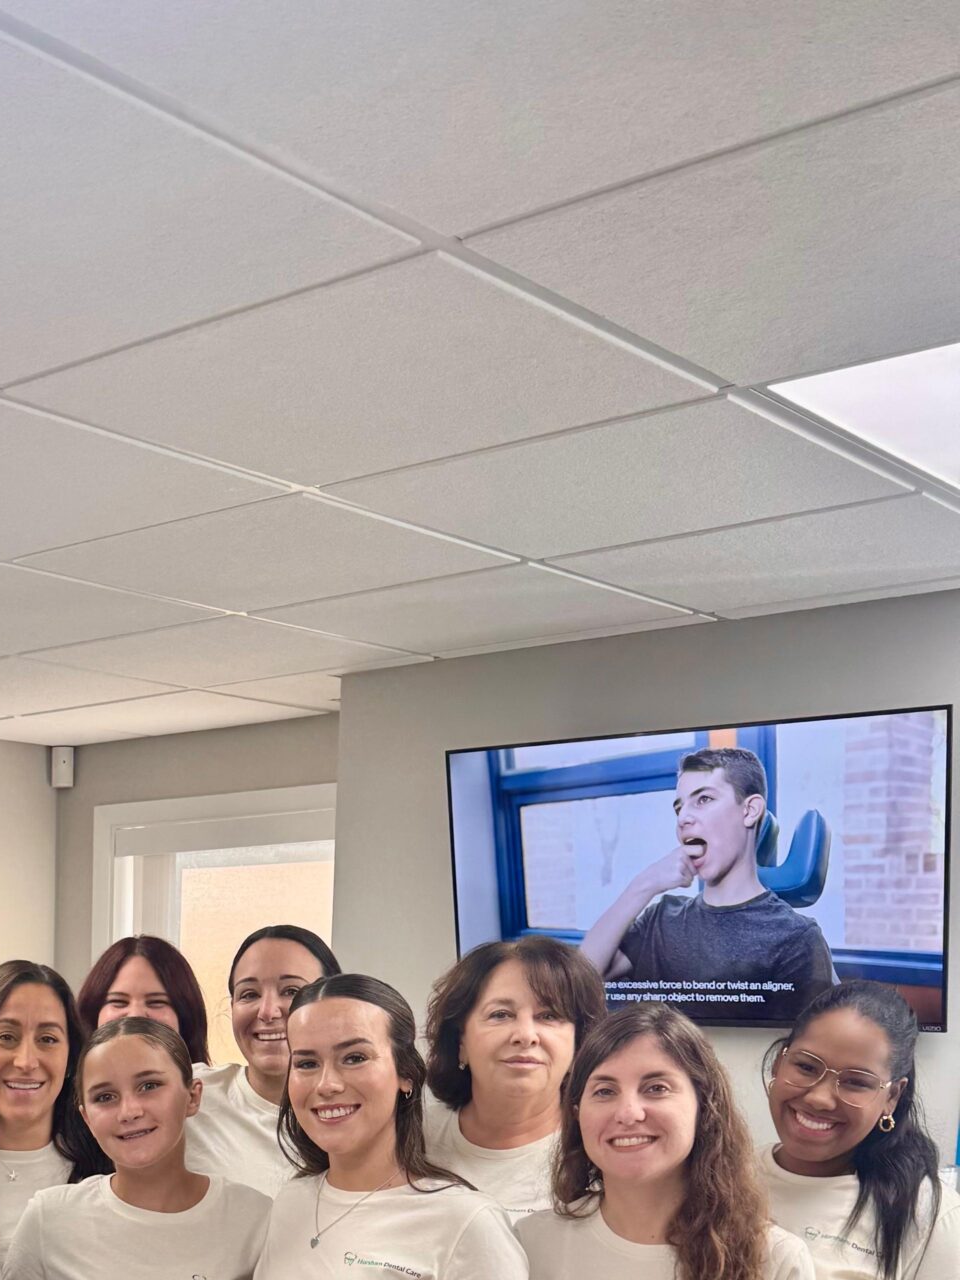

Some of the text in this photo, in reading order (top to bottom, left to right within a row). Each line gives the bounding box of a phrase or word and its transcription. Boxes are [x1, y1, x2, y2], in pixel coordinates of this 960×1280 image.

[618, 981, 658, 990] excessive
[659, 980, 682, 990] force
[683, 981, 692, 989] to
[692, 981, 716, 990] bend
[716, 982, 726, 990] or
[727, 981, 749, 990] twist
[762, 981, 795, 992] aligner,
[611, 993, 626, 1001] use
[627, 994, 642, 1003] any
[643, 993, 667, 1003] sharp
[668, 993, 695, 1003] object
[740, 995, 765, 1003] them.
[384, 1262, 406, 1273] Dental
[406, 1268, 422, 1279] Care
